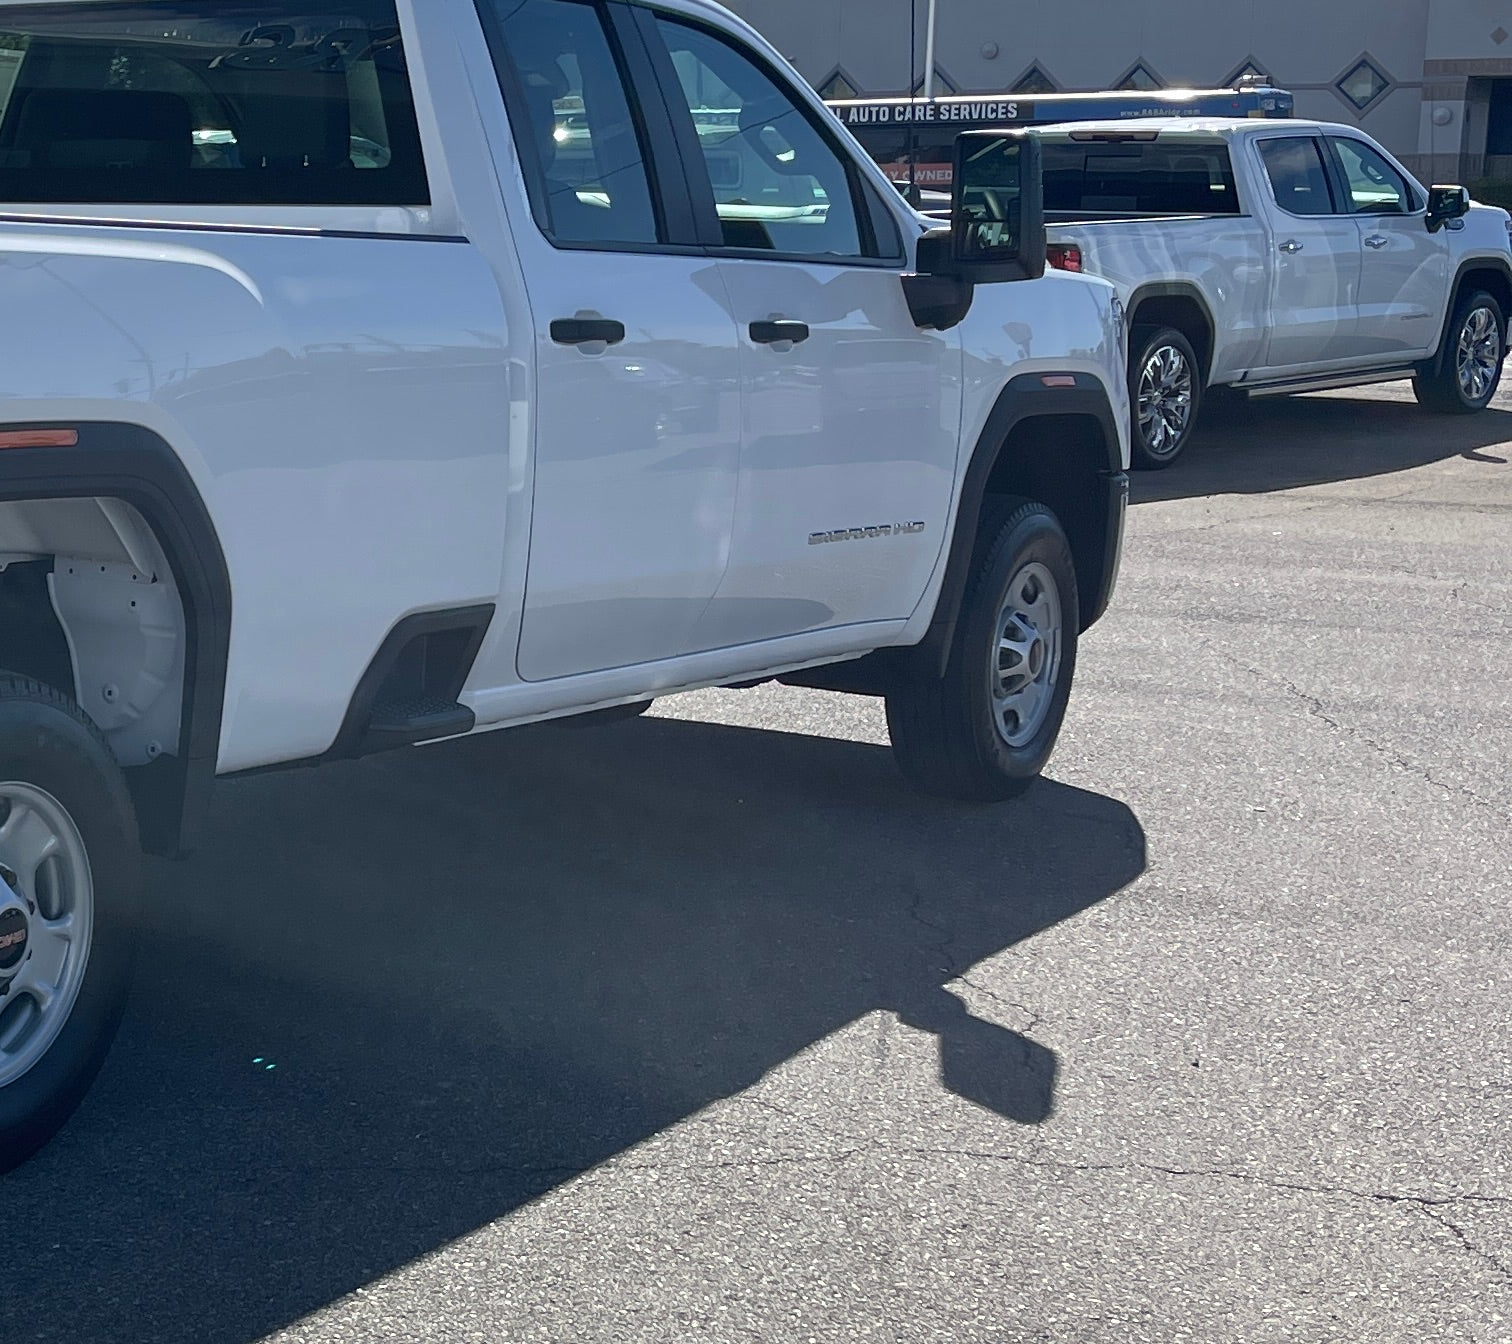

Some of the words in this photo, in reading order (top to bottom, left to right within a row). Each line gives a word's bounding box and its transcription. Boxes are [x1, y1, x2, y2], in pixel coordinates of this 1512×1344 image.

[849, 106, 889, 123] AUTO
[895, 105, 935, 121] CARE
[940, 102, 1018, 120] SERVICES
